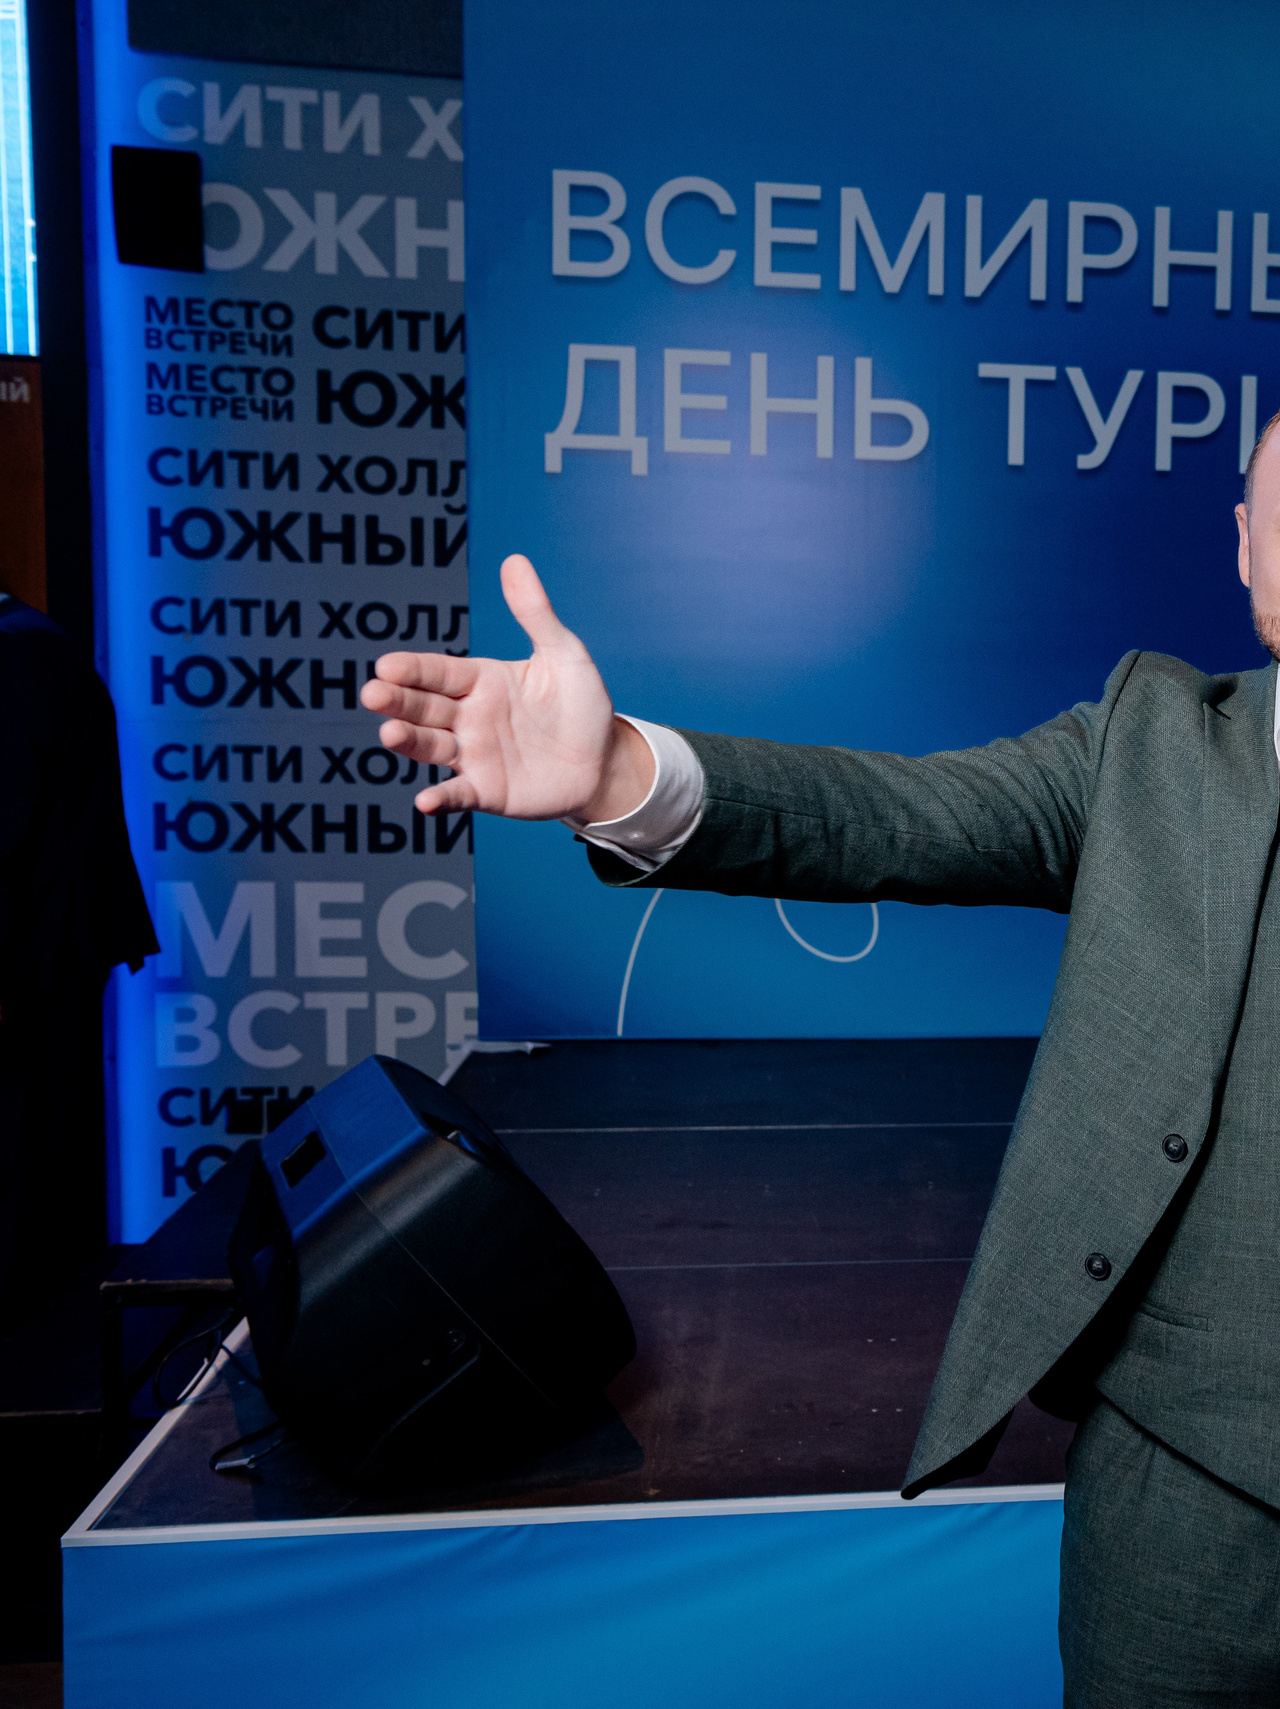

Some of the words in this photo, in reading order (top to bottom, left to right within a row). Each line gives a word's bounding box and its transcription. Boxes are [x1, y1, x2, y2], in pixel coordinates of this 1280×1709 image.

[137, 76, 382, 157] СИТИ
[143, 296, 294, 332] МЕСТО
[312, 306, 466, 353] СИТИ
[144, 328, 294, 358] ВСТРЕЧИ
[145, 362, 295, 399] МЕСТО
[145, 394, 294, 422] ВСТРЕЧИ
[544, 343, 931, 476] ДЕНЬ
[147, 447, 299, 492] СИТИ
[316, 454, 467, 497] ХОЛЛ
[147, 503, 468, 567] ЮЖНЫЙ
[150, 597, 302, 639] СИТИ
[318, 602, 469, 641] ХОЛЛ
[151, 649, 469, 710] ЮЖН
[152, 744, 303, 783] СИТИ
[320, 746, 457, 784] ХОЛ
[154, 879, 475, 980] МЕС
